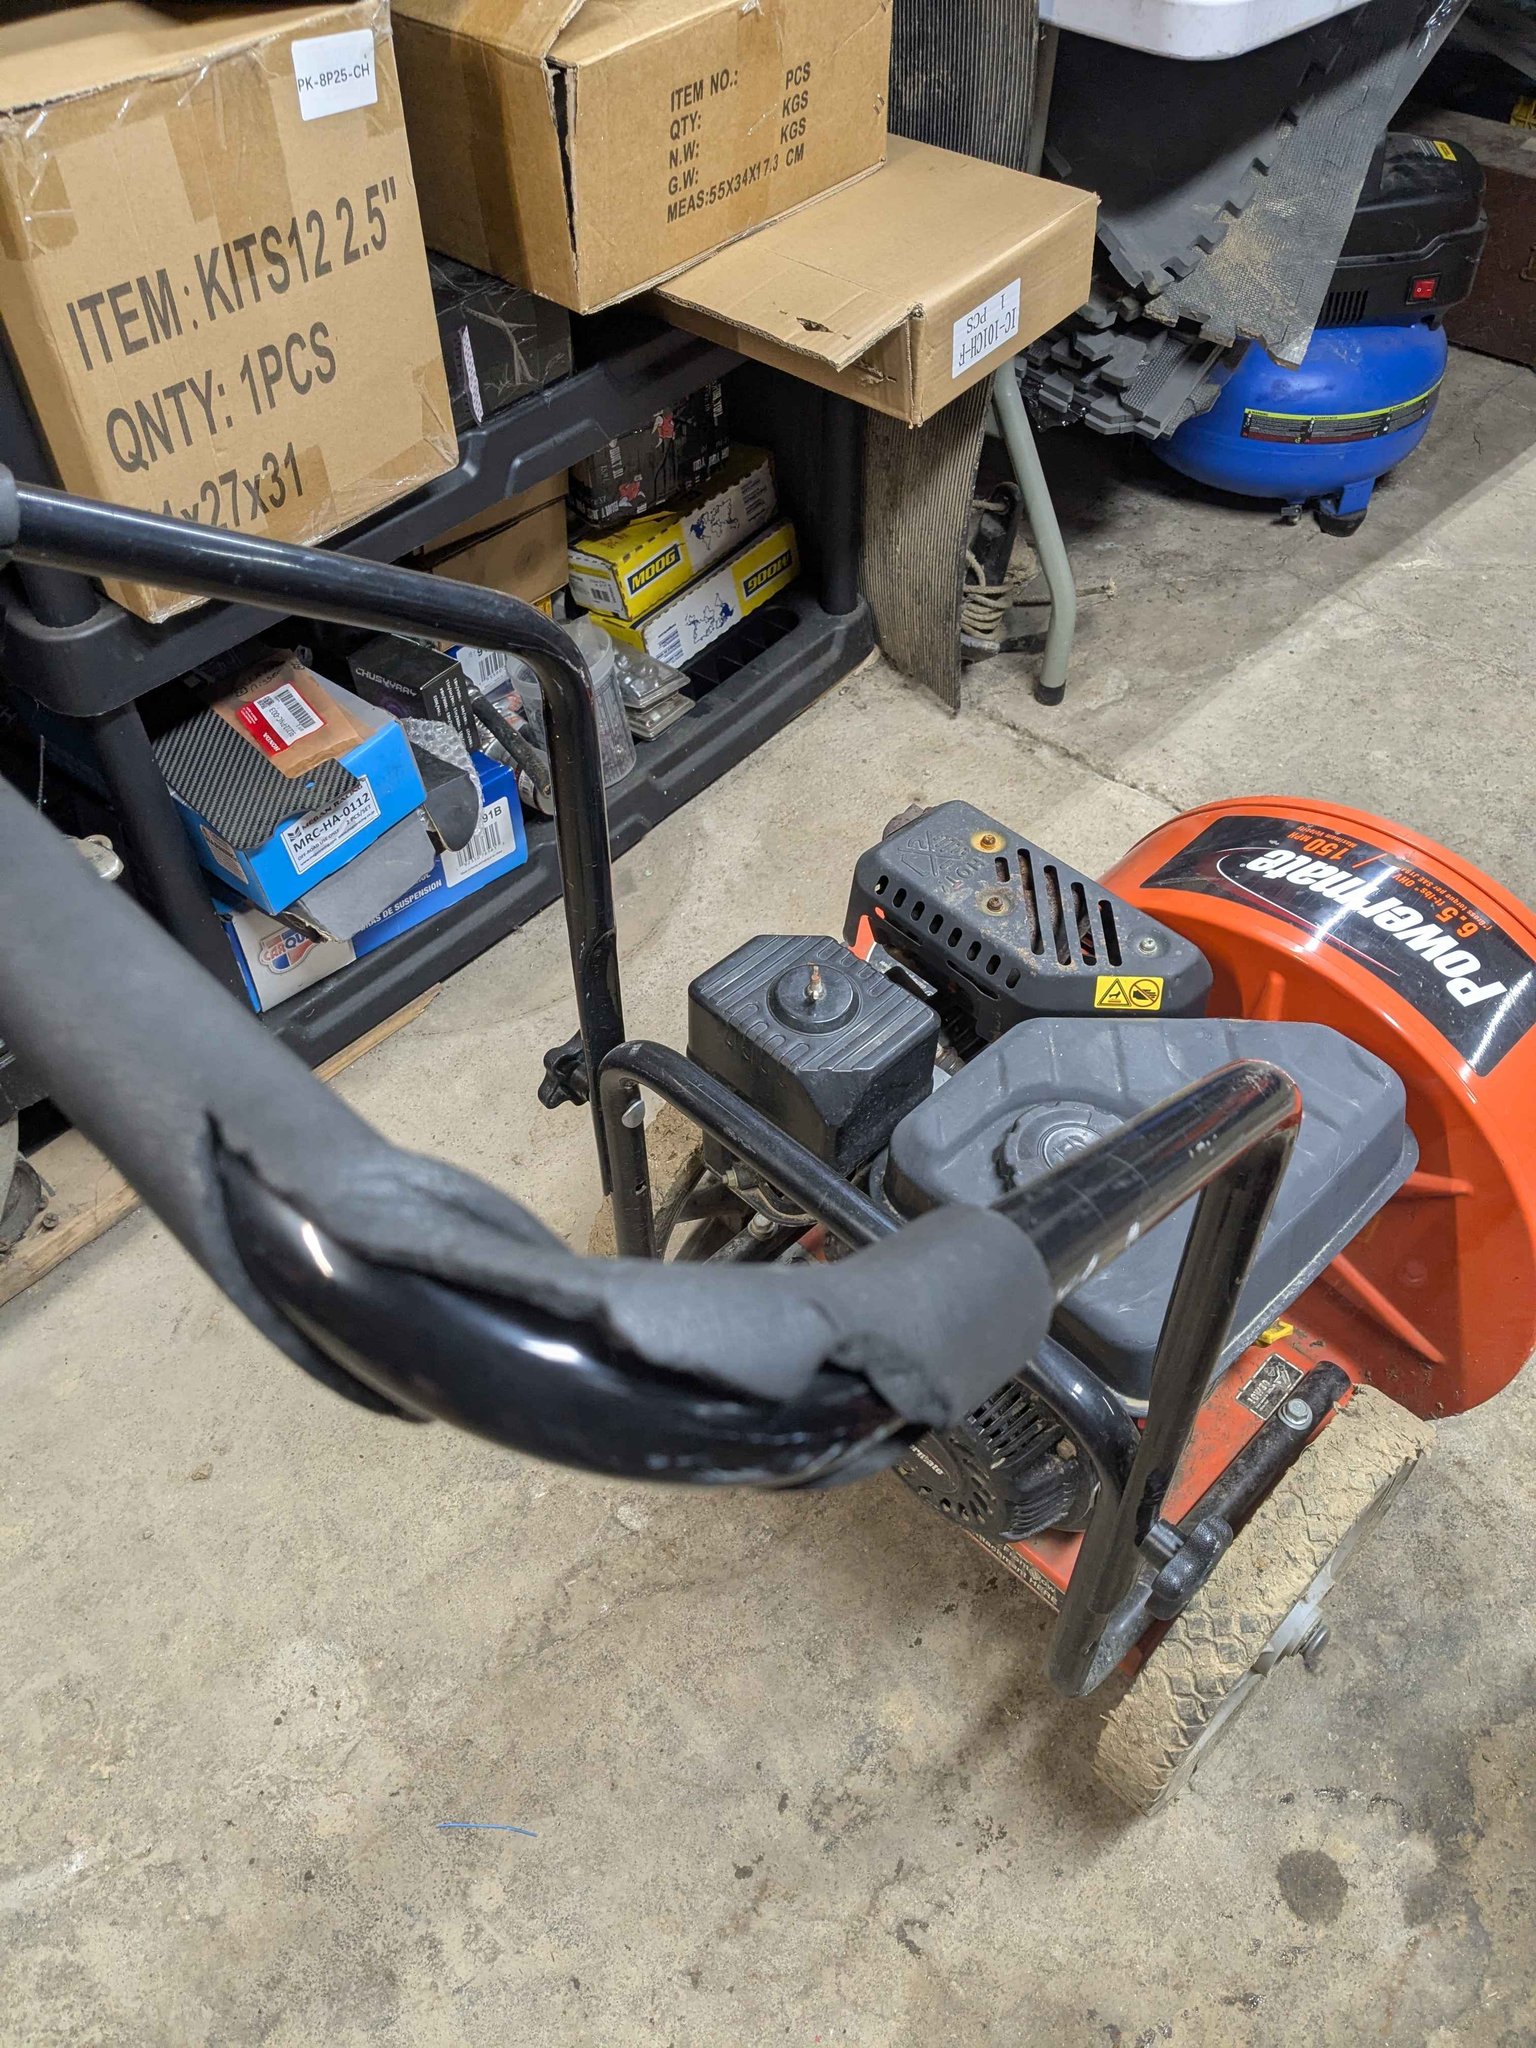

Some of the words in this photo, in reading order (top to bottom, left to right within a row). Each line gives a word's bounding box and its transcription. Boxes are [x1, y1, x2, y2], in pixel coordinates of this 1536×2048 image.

[297, 63, 370, 92] PK-8P25-CH
[670, 79, 704, 113] ITEM
[710, 68, 738, 96] NO.:
[669, 110, 702, 141] QTY:
[785, 61, 811, 90] PCS
[669, 140, 699, 169] N.W:
[782, 90, 809, 118] KGS
[668, 167, 699, 196] G.W:
[780, 117, 806, 144] KGS
[785, 143, 805, 166] CM
[1000, 293, 1006, 310] 1
[966, 306, 988, 334] PCS
[958, 307, 1017, 367] IC-101CH-F
[105, 369, 235, 474] QNTY:
[240, 321, 338, 416] 1PCS
[632, 550, 676, 591] MOOG
[747, 553, 790, 593] MOOG
[263, 732, 280, 752] HONDA
[293, 792, 371, 853] MRC-HA-0112
[1287, 831, 1313, 842] MPH
[1303, 838, 1350, 860] 150
[1392, 874, 1416, 887] OHV
[1418, 877, 1434, 887] SAE
[1433, 886, 1447, 895] per
[382, 909, 394, 918] DE
[394, 879, 442, 911] SUSPENSION
[1445, 894, 1468, 911] torque
[1246, 848, 1508, 1007] Powermate
[1028, 1577, 1059, 1606] HERE
